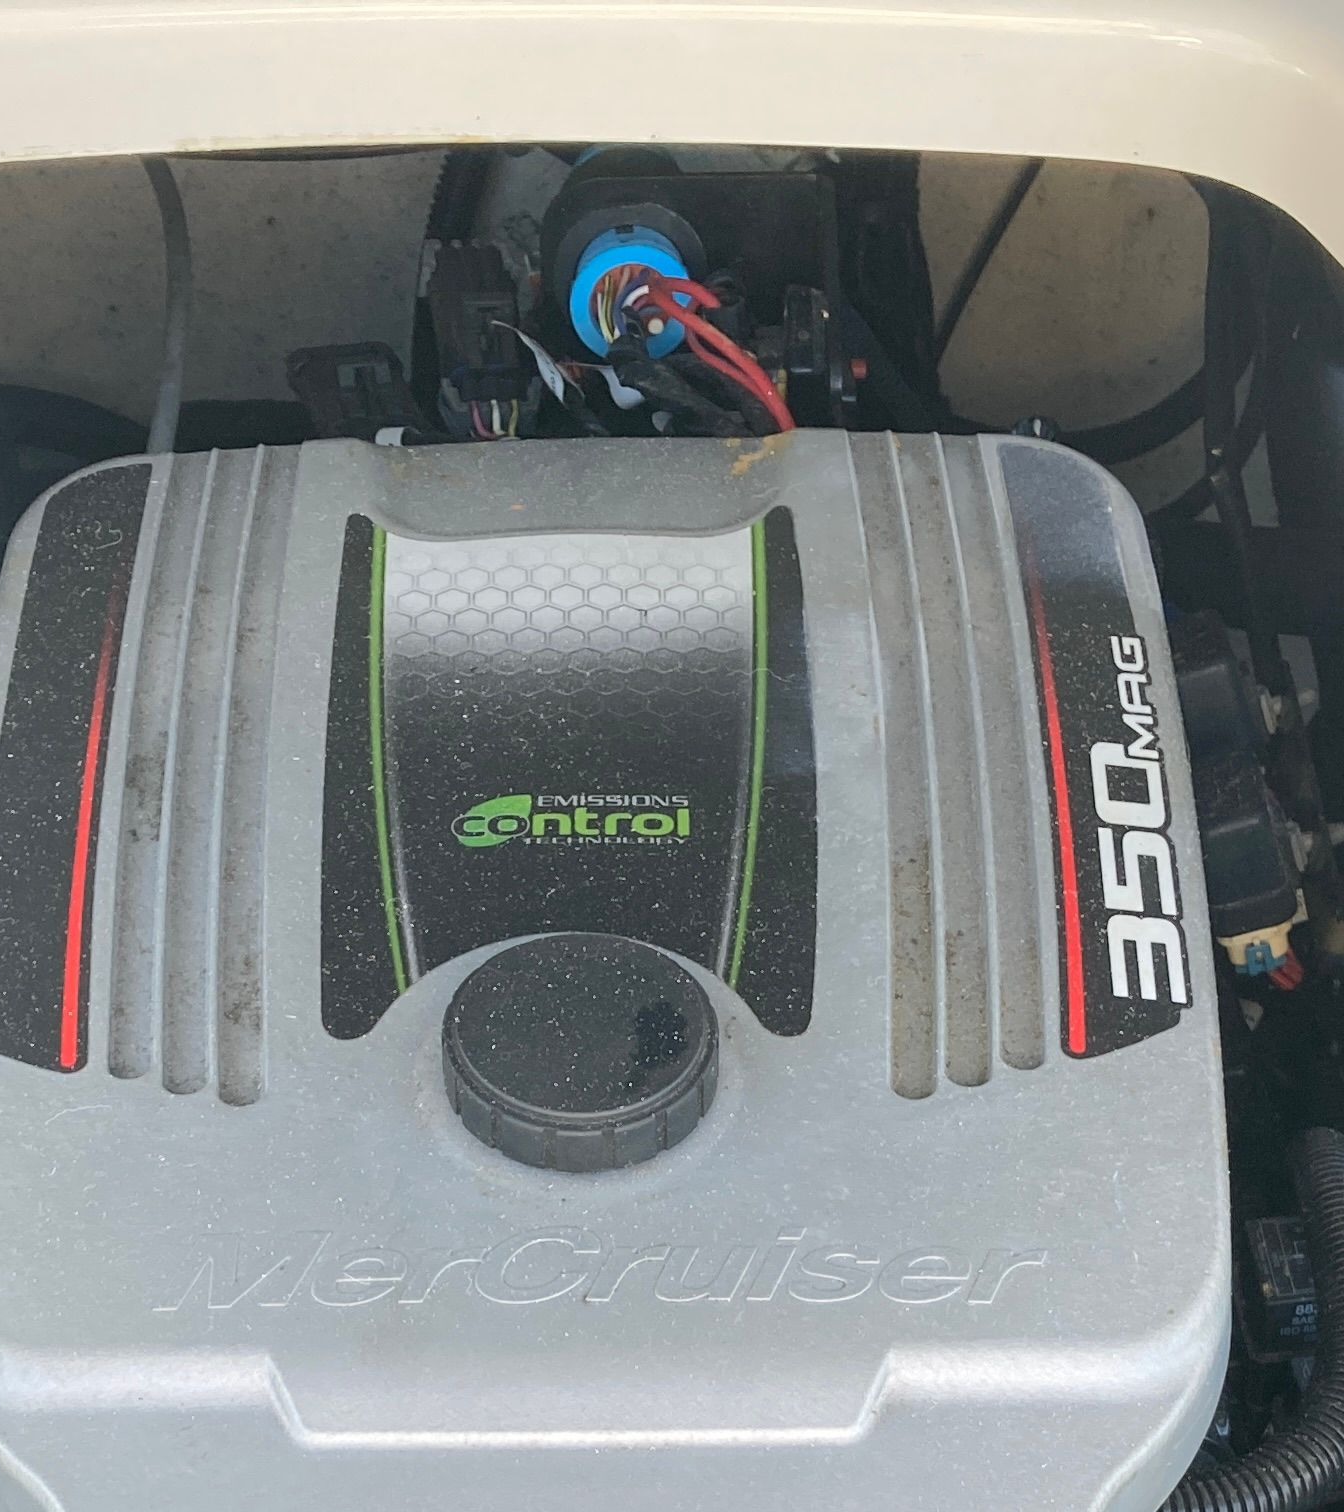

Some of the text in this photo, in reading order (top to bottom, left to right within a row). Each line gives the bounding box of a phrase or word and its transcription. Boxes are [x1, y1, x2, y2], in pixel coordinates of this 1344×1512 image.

[451, 808, 691, 837] control
[537, 795, 689, 807] EMISSIONS
[1089, 635, 1188, 1005] 350 MAG
[153, 1225, 1048, 1313] MerCruiser
